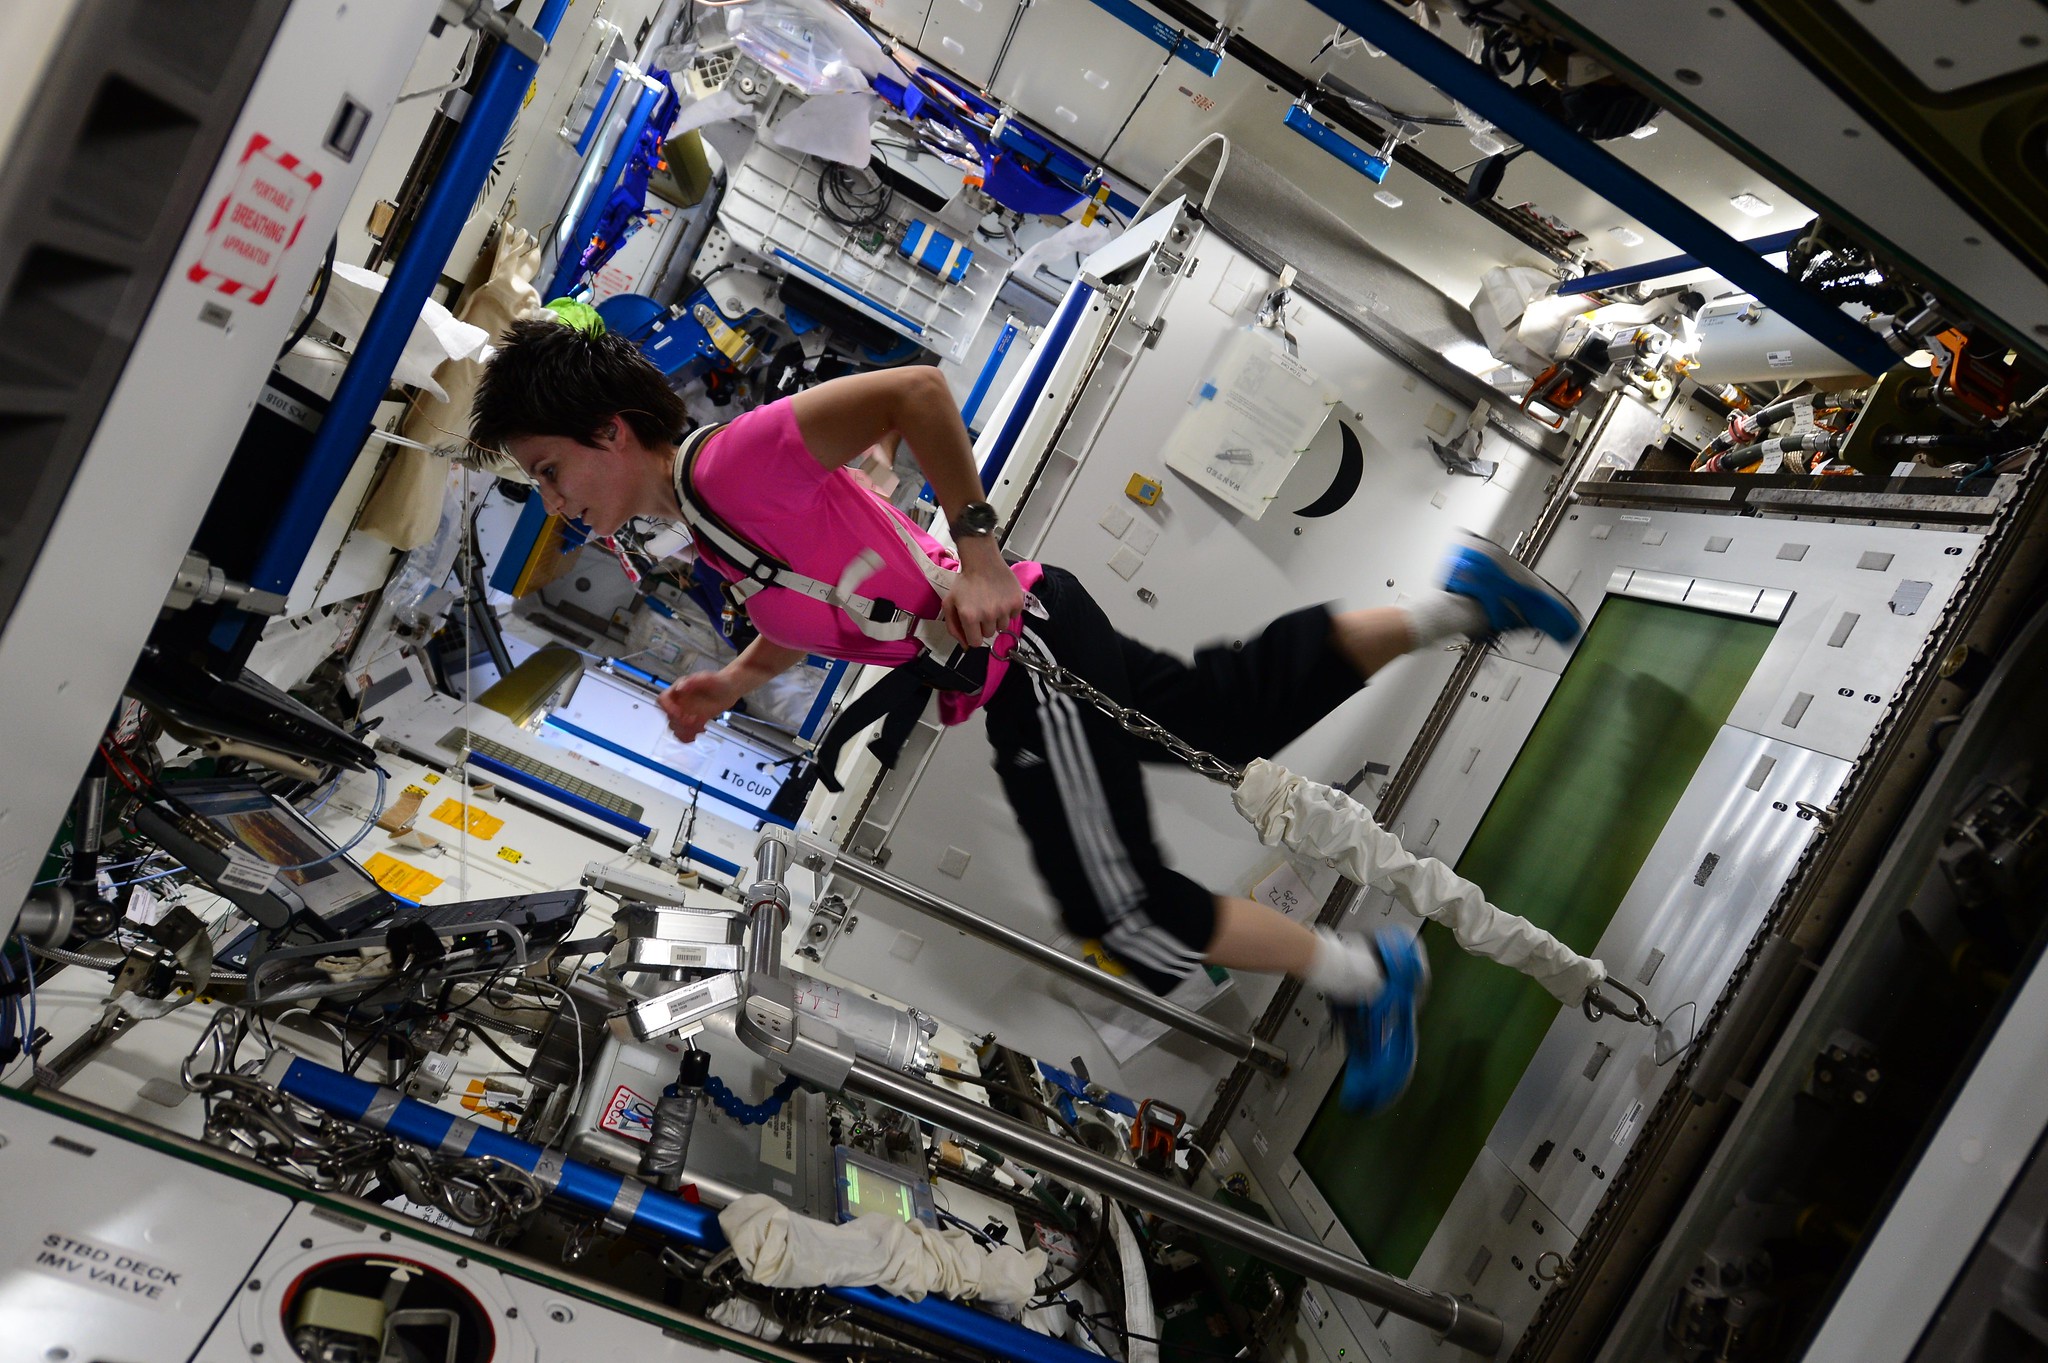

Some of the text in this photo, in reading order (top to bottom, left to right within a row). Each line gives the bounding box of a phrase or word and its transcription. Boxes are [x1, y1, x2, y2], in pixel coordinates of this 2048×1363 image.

[253, 178, 295, 213] PORTABLE
[231, 203, 287, 244] BREATHING
[222, 234, 271, 267] APPARATUS
[265, 393, 308, 420] PCS 1018
[1206, 466, 1241, 491] WANTED
[731, 773, 772, 797] To CUP
[1269, 886, 1293, 914] No T2
[606, 1093, 631, 1126] TOCA
[36, 1251, 163, 1300] IMV VALVE
[43, 1234, 182, 1286] STBD DECK
